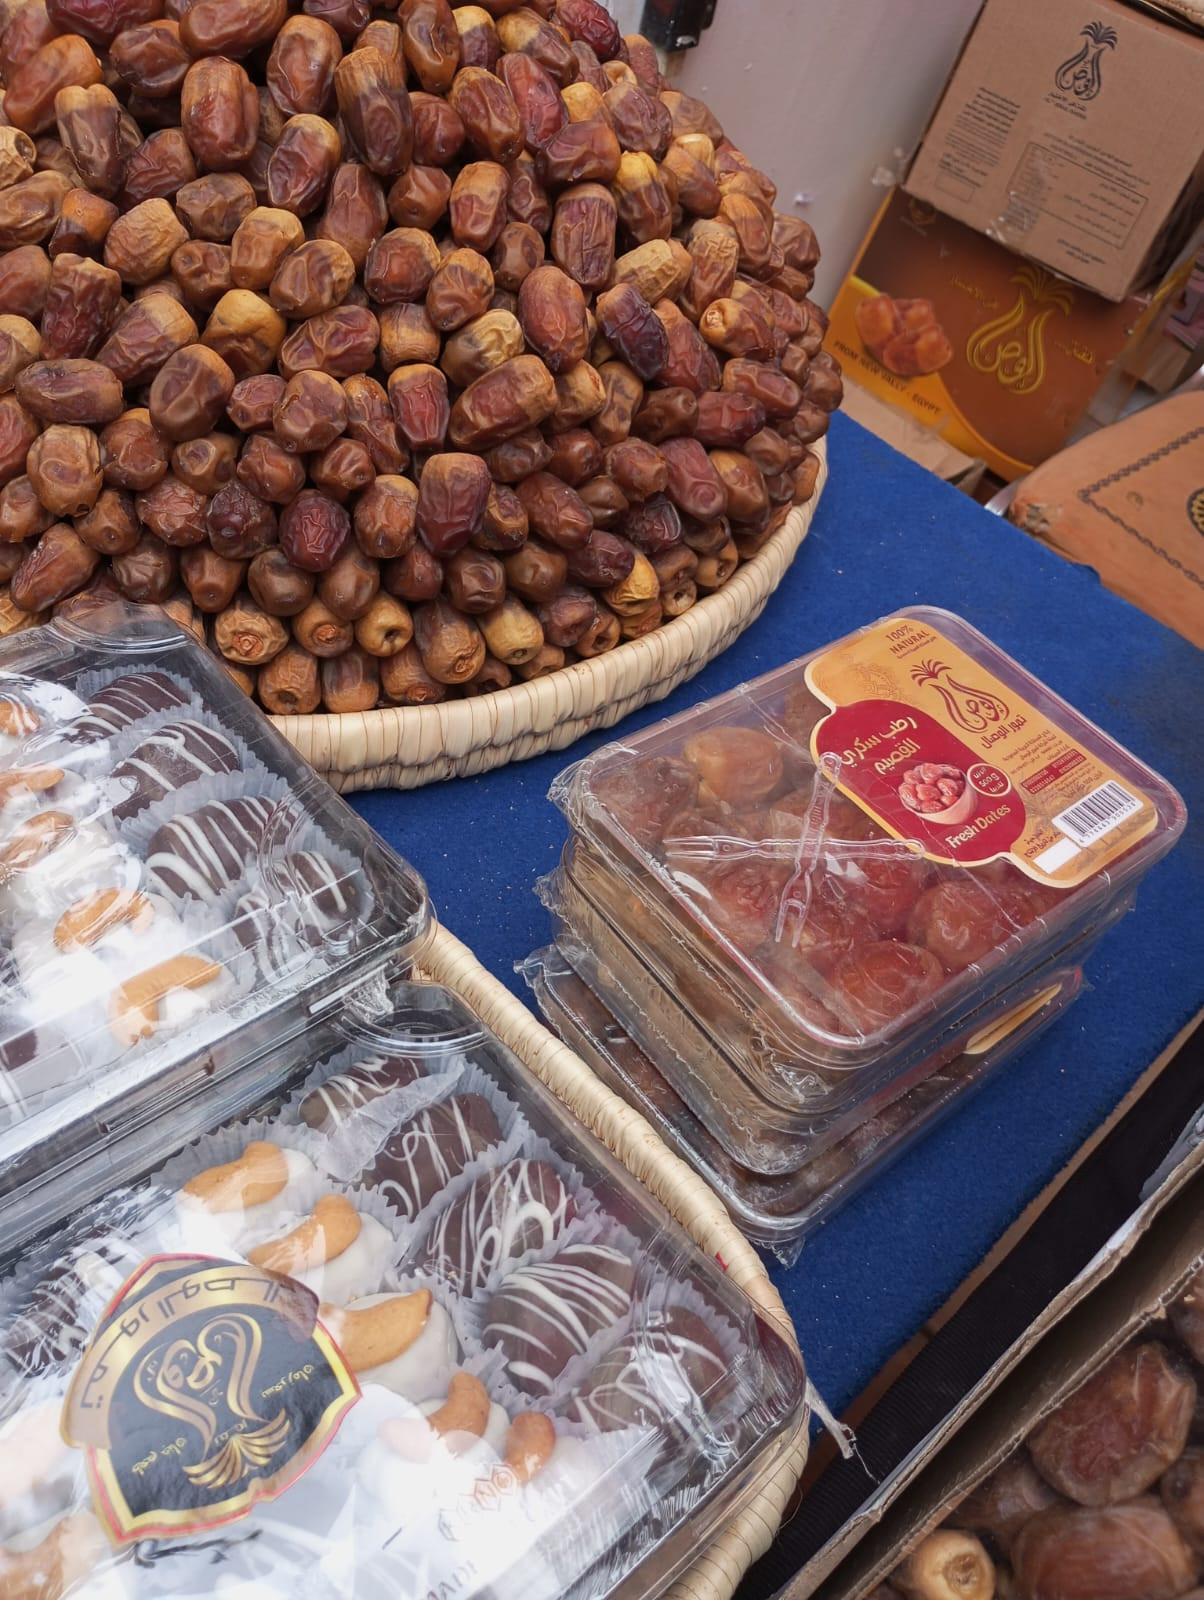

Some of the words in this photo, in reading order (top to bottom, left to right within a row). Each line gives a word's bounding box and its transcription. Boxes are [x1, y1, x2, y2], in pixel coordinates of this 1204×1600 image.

[885, 625, 913, 641] 100%
[889, 630, 930, 653] NATURAL
[879, 717, 917, 739] رطب
[1008, 714, 1027, 733] تمور
[981, 724, 1010, 749] الوصال
[840, 737, 882, 767] سكري
[874, 737, 921, 775] القصيم
[945, 825, 980, 848] Fresh
[974, 804, 1011, 829] Dates
